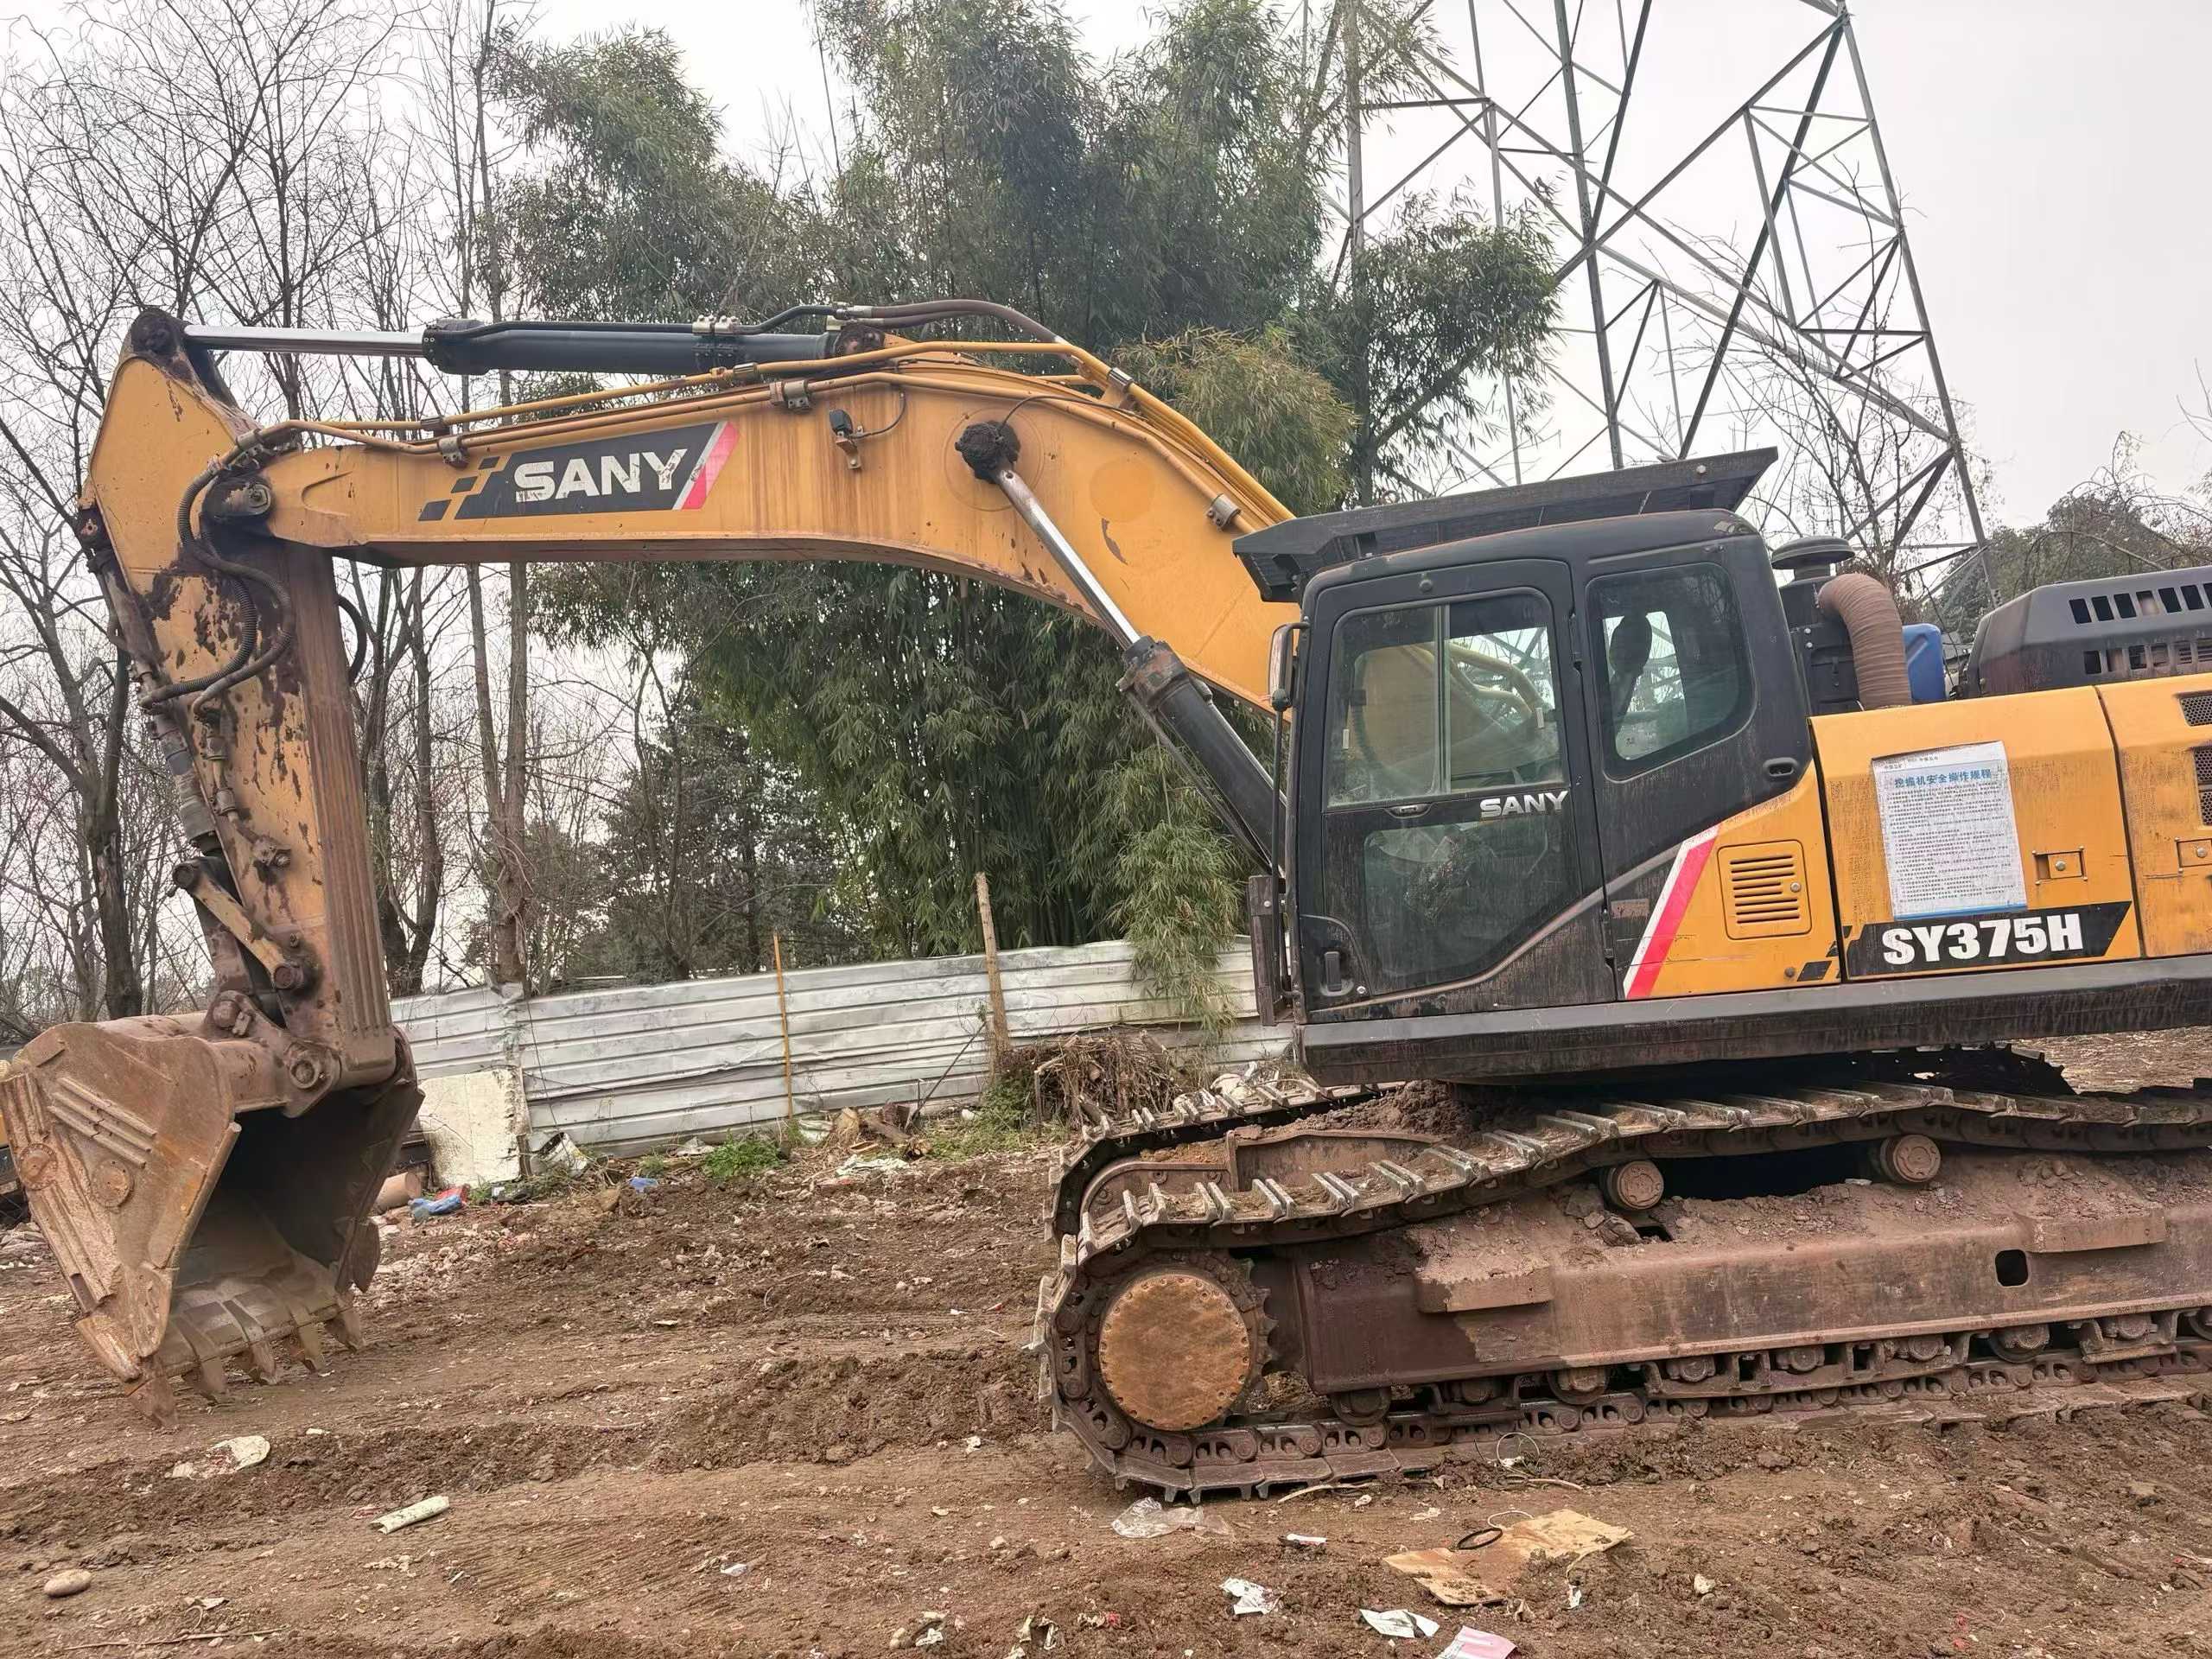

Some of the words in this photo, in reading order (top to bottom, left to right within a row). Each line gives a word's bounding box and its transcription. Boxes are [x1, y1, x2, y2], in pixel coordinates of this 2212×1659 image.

[514, 448, 688, 503] SANY
[1479, 791, 1568, 817] SANY
[1882, 913, 2083, 965] SY375H
